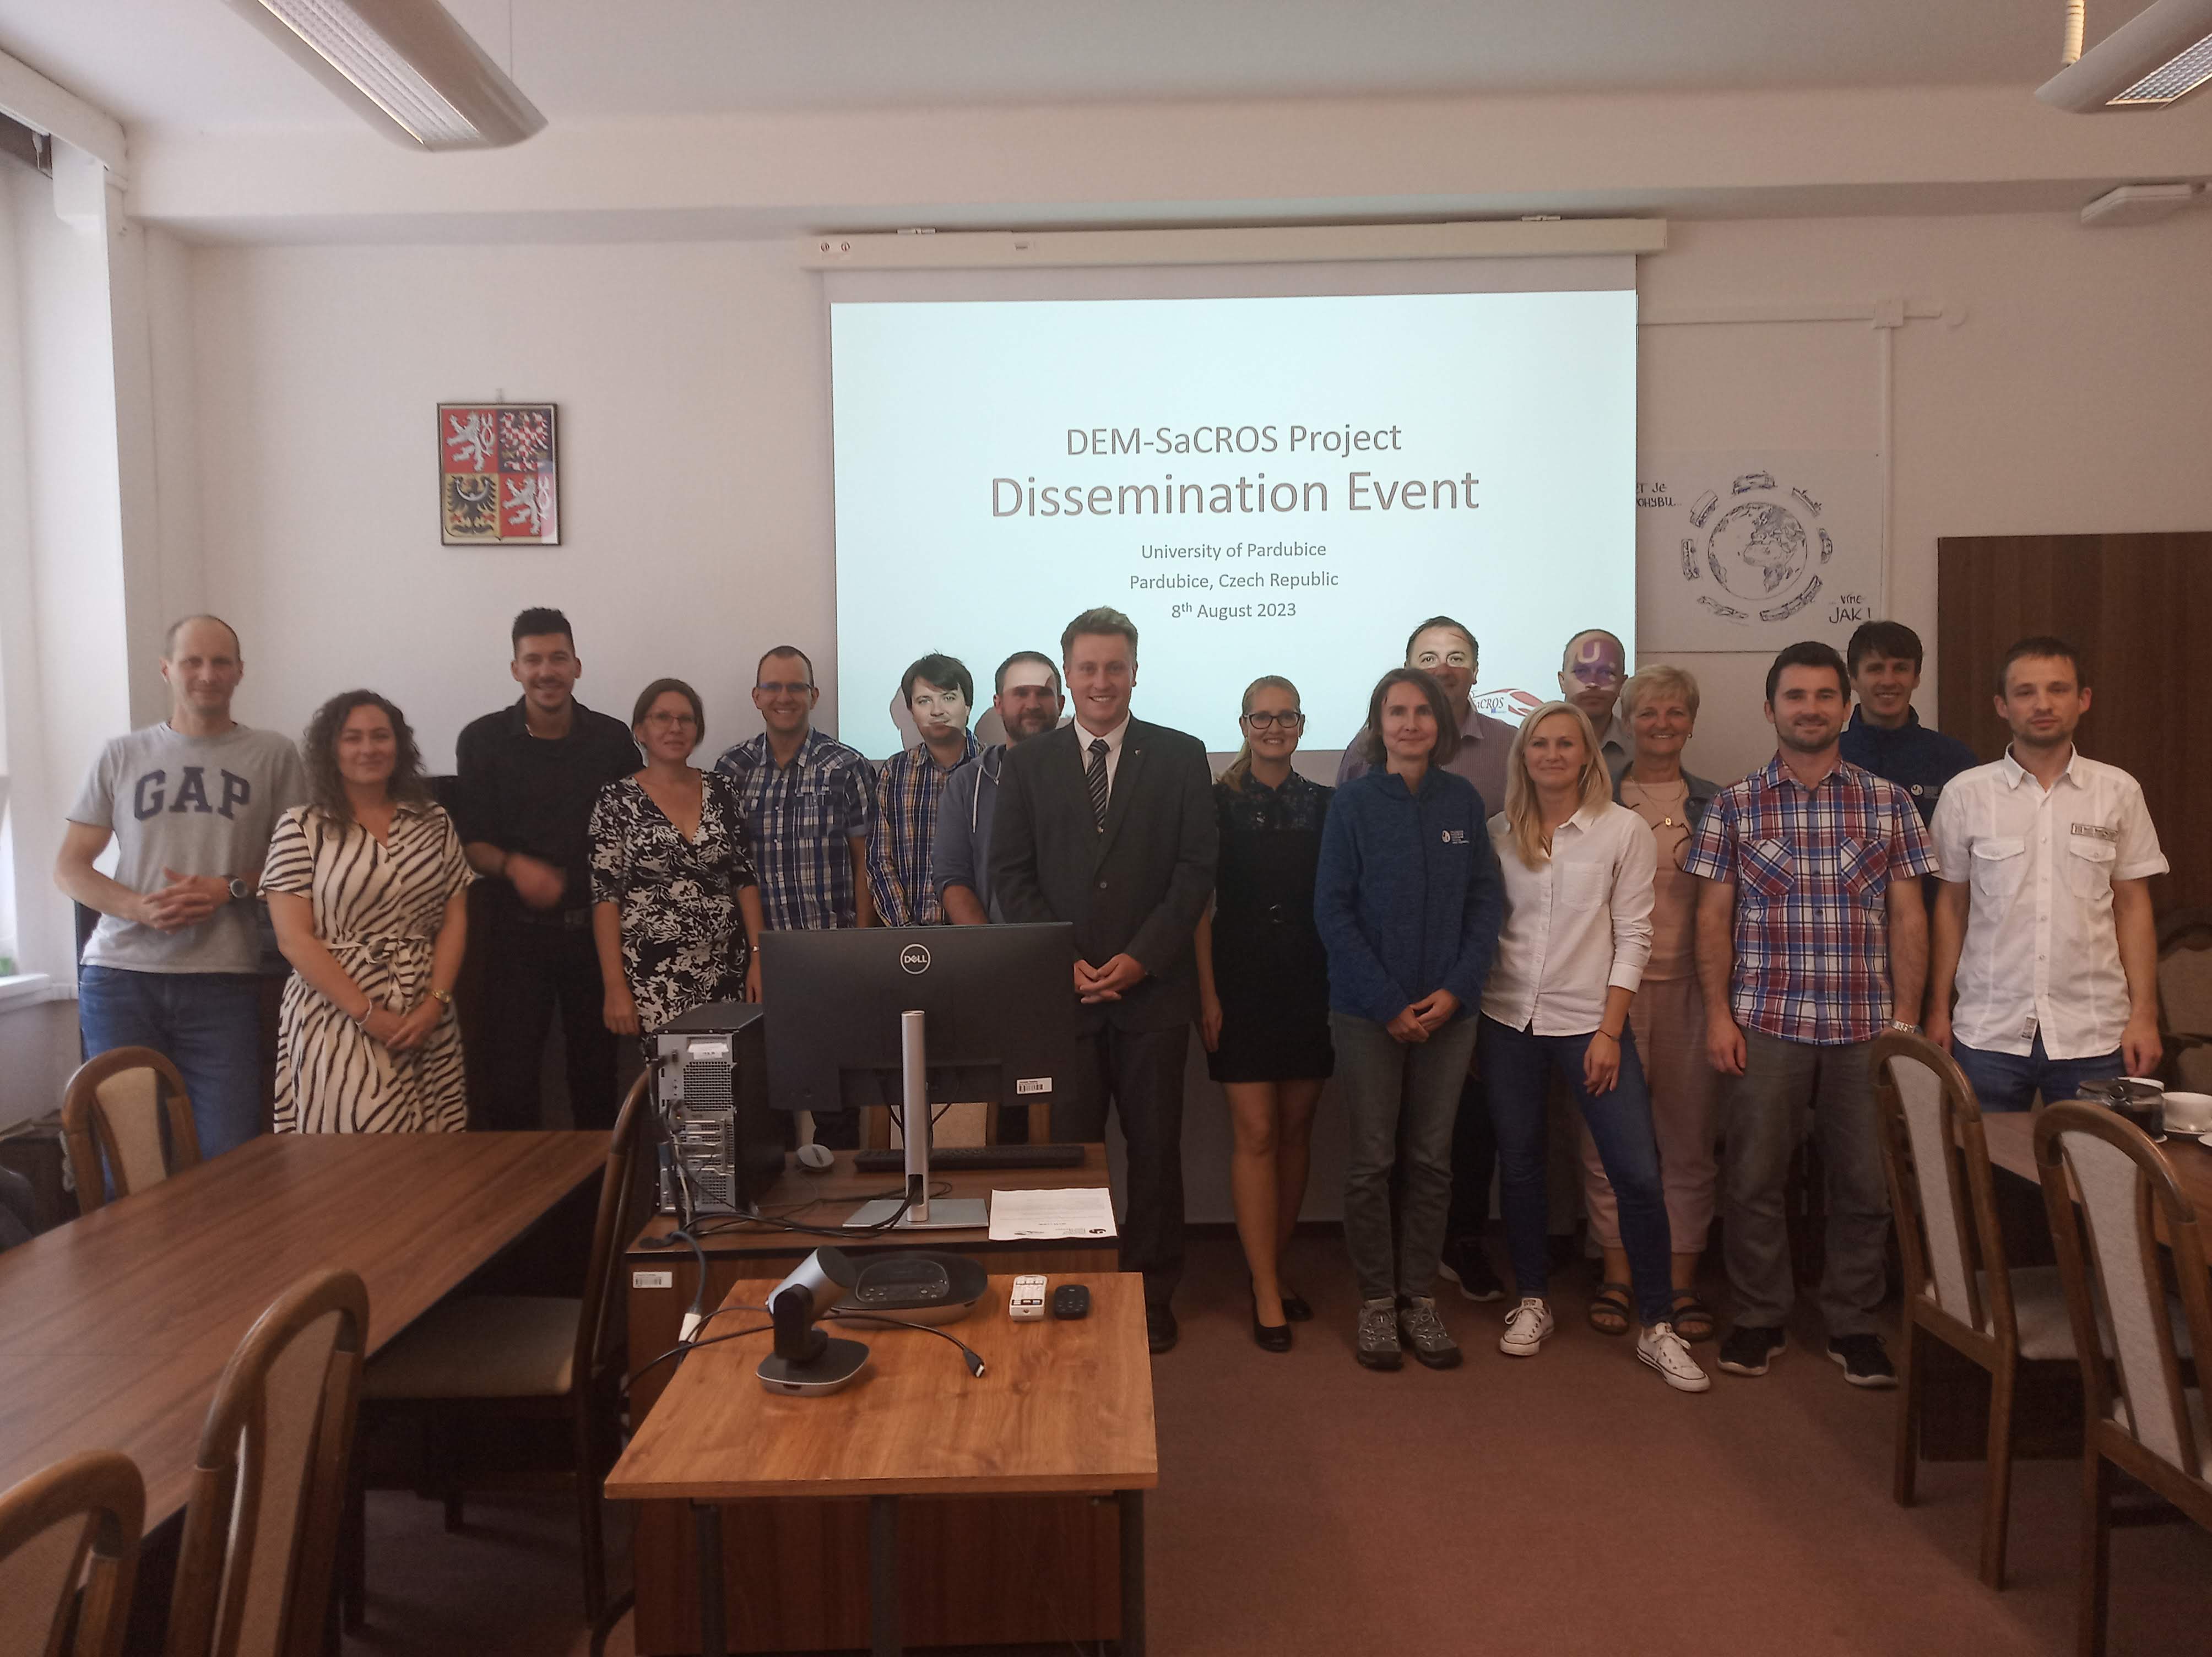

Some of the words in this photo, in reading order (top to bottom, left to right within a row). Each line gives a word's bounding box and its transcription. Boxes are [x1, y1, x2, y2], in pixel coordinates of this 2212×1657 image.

[1067, 426, 1278, 456] DEM-SaCROS
[1291, 424, 1402, 459] Project
[992, 473, 1328, 518] Dissemination
[1349, 472, 1481, 512] Event
[1142, 543, 1222, 561] University
[1227, 542, 1244, 558] of
[1248, 540, 1327, 559] Pardubice
[1131, 573, 1214, 592] Pardubice,
[1219, 572, 1265, 589] Czech
[1270, 570, 1339, 590] Republic
[1172, 603, 1193, 619] 8th
[1197, 604, 1253, 621] August
[1257, 603, 1297, 618] 2023
[134, 766, 251, 821] GAP
[904, 955, 928, 963] DELL
